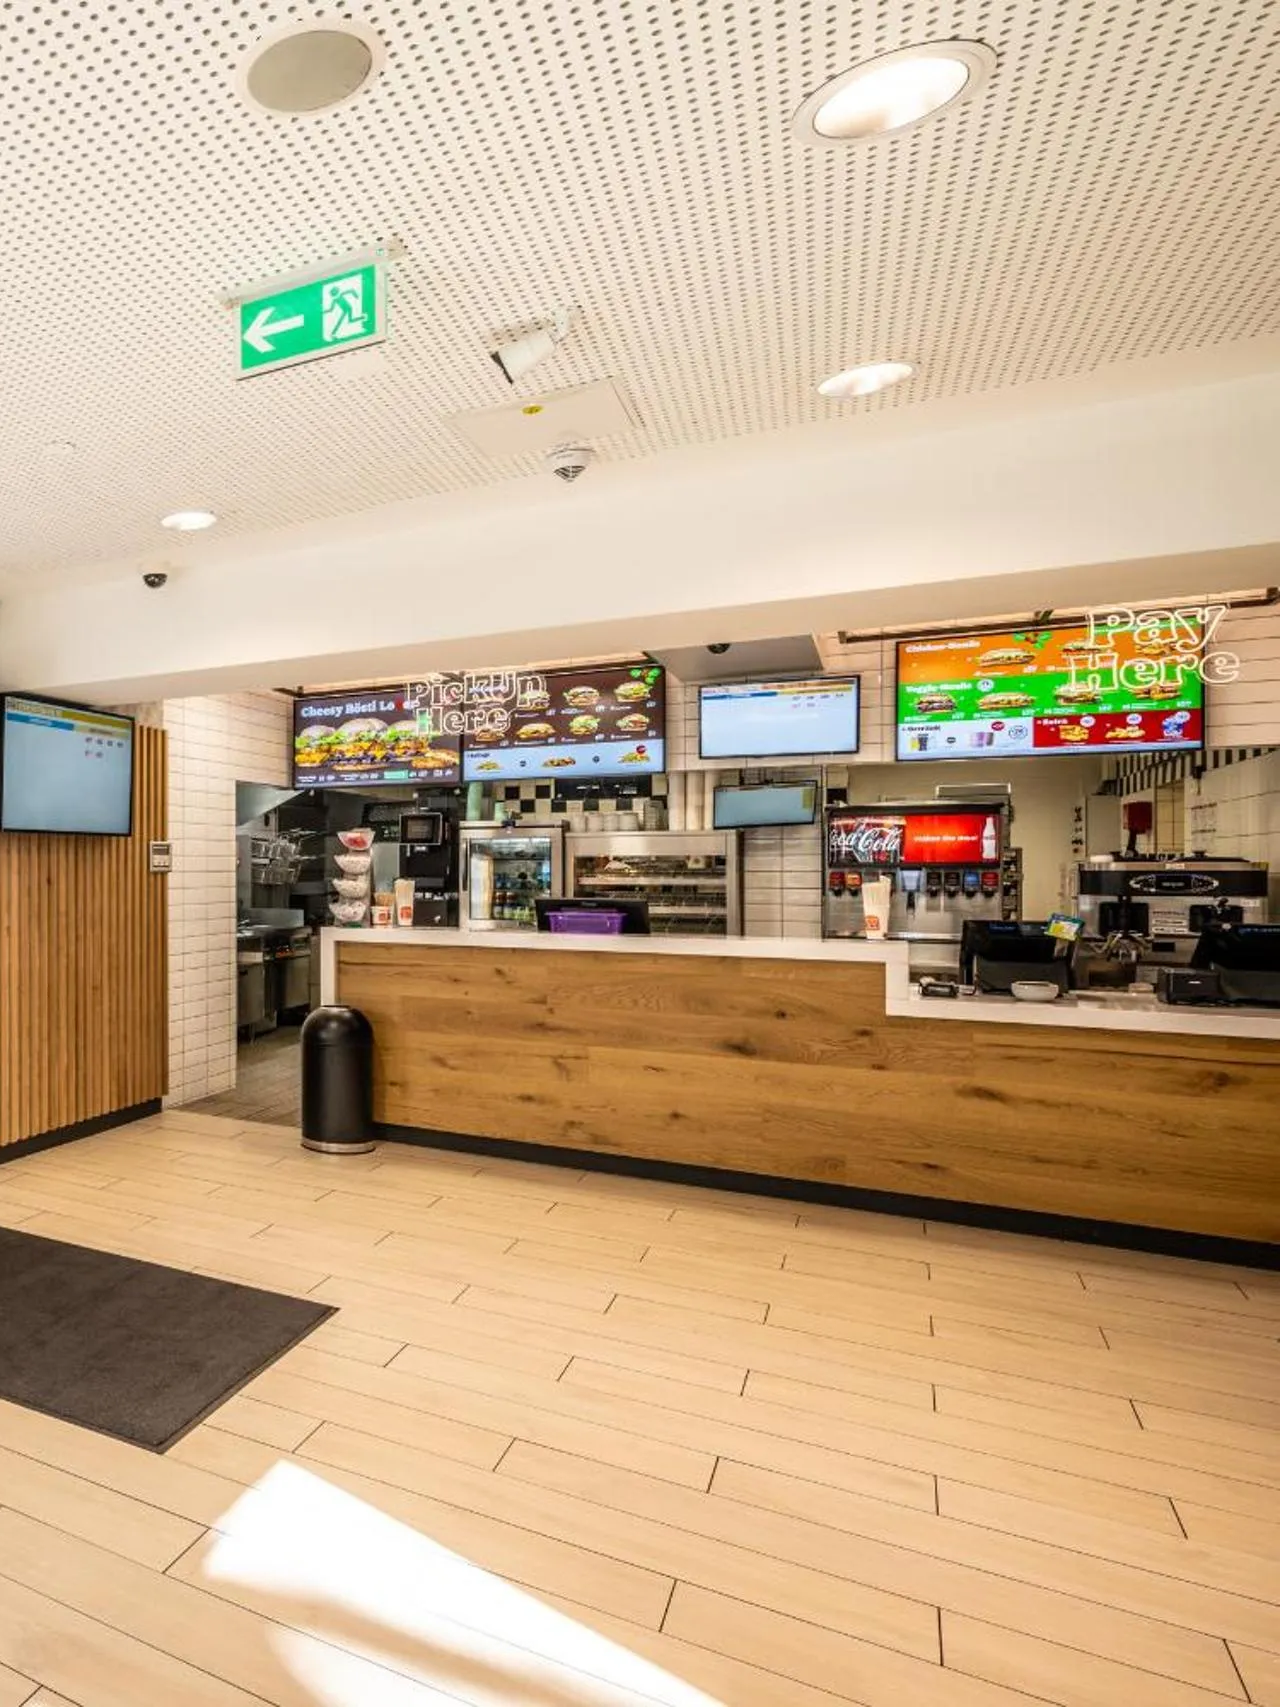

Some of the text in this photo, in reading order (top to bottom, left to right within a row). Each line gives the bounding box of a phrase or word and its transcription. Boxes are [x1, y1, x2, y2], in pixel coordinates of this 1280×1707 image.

[1087, 605, 1227, 653] Pay
[1066, 651, 1241, 692] Here
[301, 704, 343, 718] Cheesy
[345, 701, 377, 715] Rösti
[414, 706, 512, 735] Here
